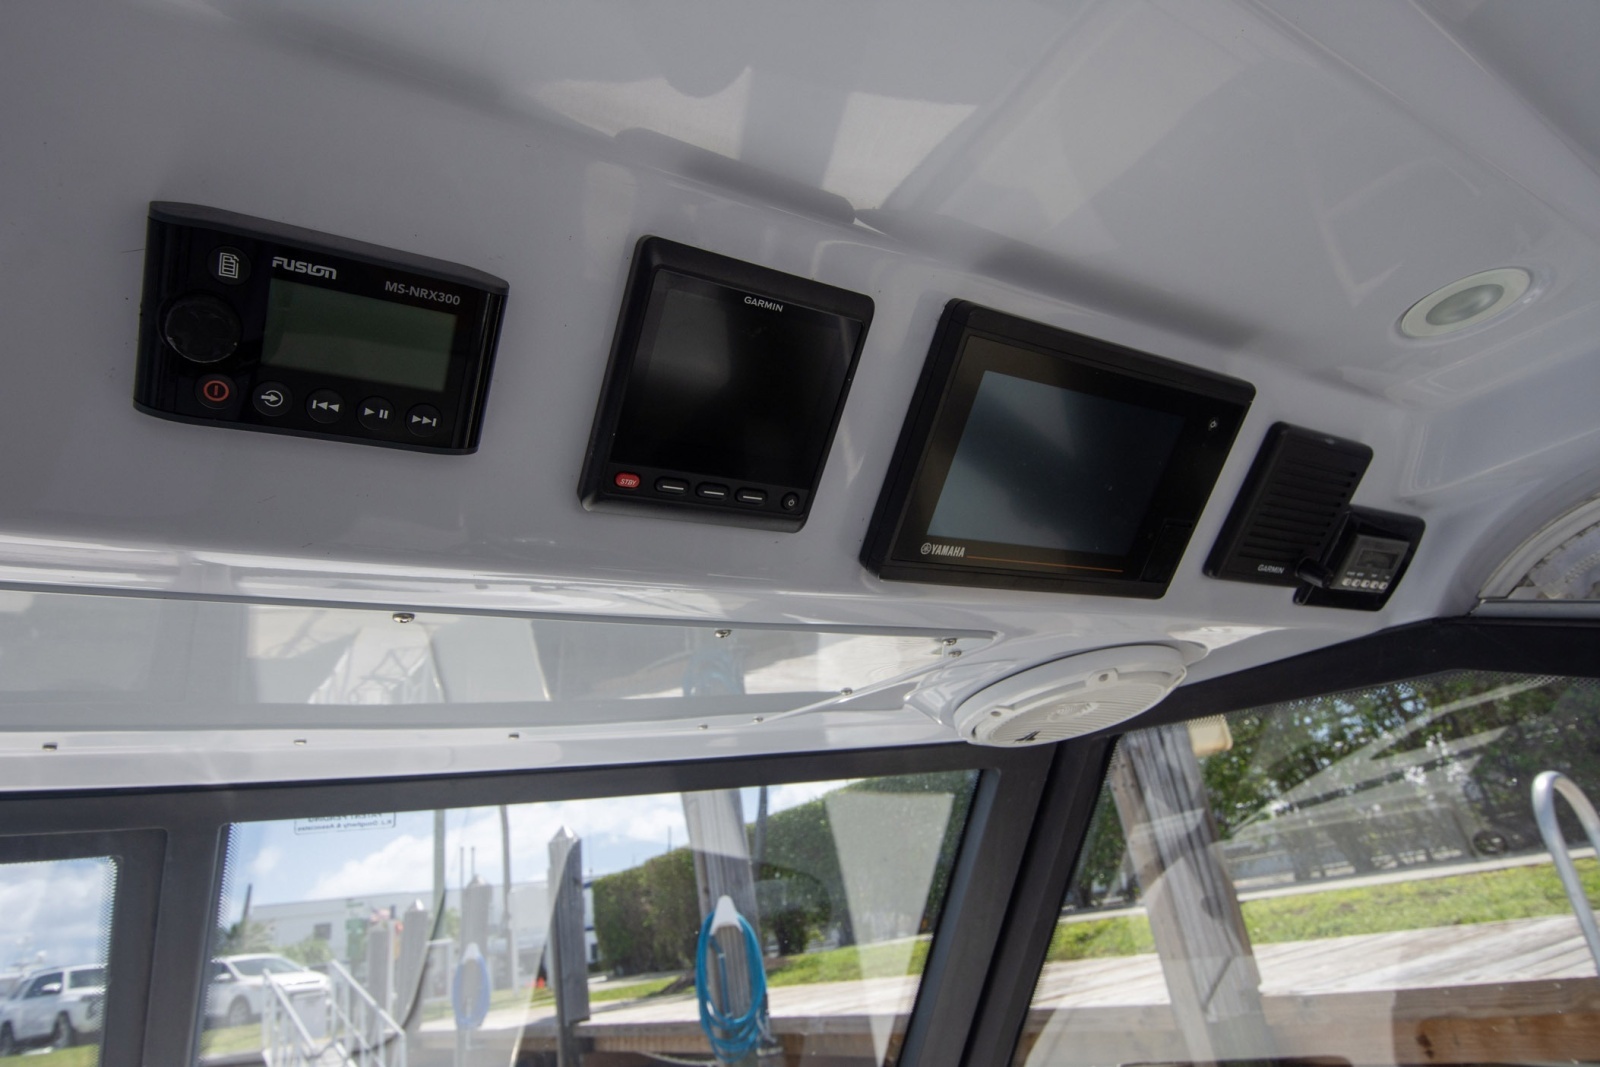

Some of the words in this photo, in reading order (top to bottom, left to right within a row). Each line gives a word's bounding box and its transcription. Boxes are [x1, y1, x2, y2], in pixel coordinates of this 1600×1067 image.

[272, 256, 337, 280] FUSION
[384, 280, 461, 306] MS-NRX300
[744, 296, 784, 313] GARMIN
[620, 478, 636, 486] STBY
[931, 544, 966, 558] YAMAHA
[1257, 563, 1285, 574] GARMIN
